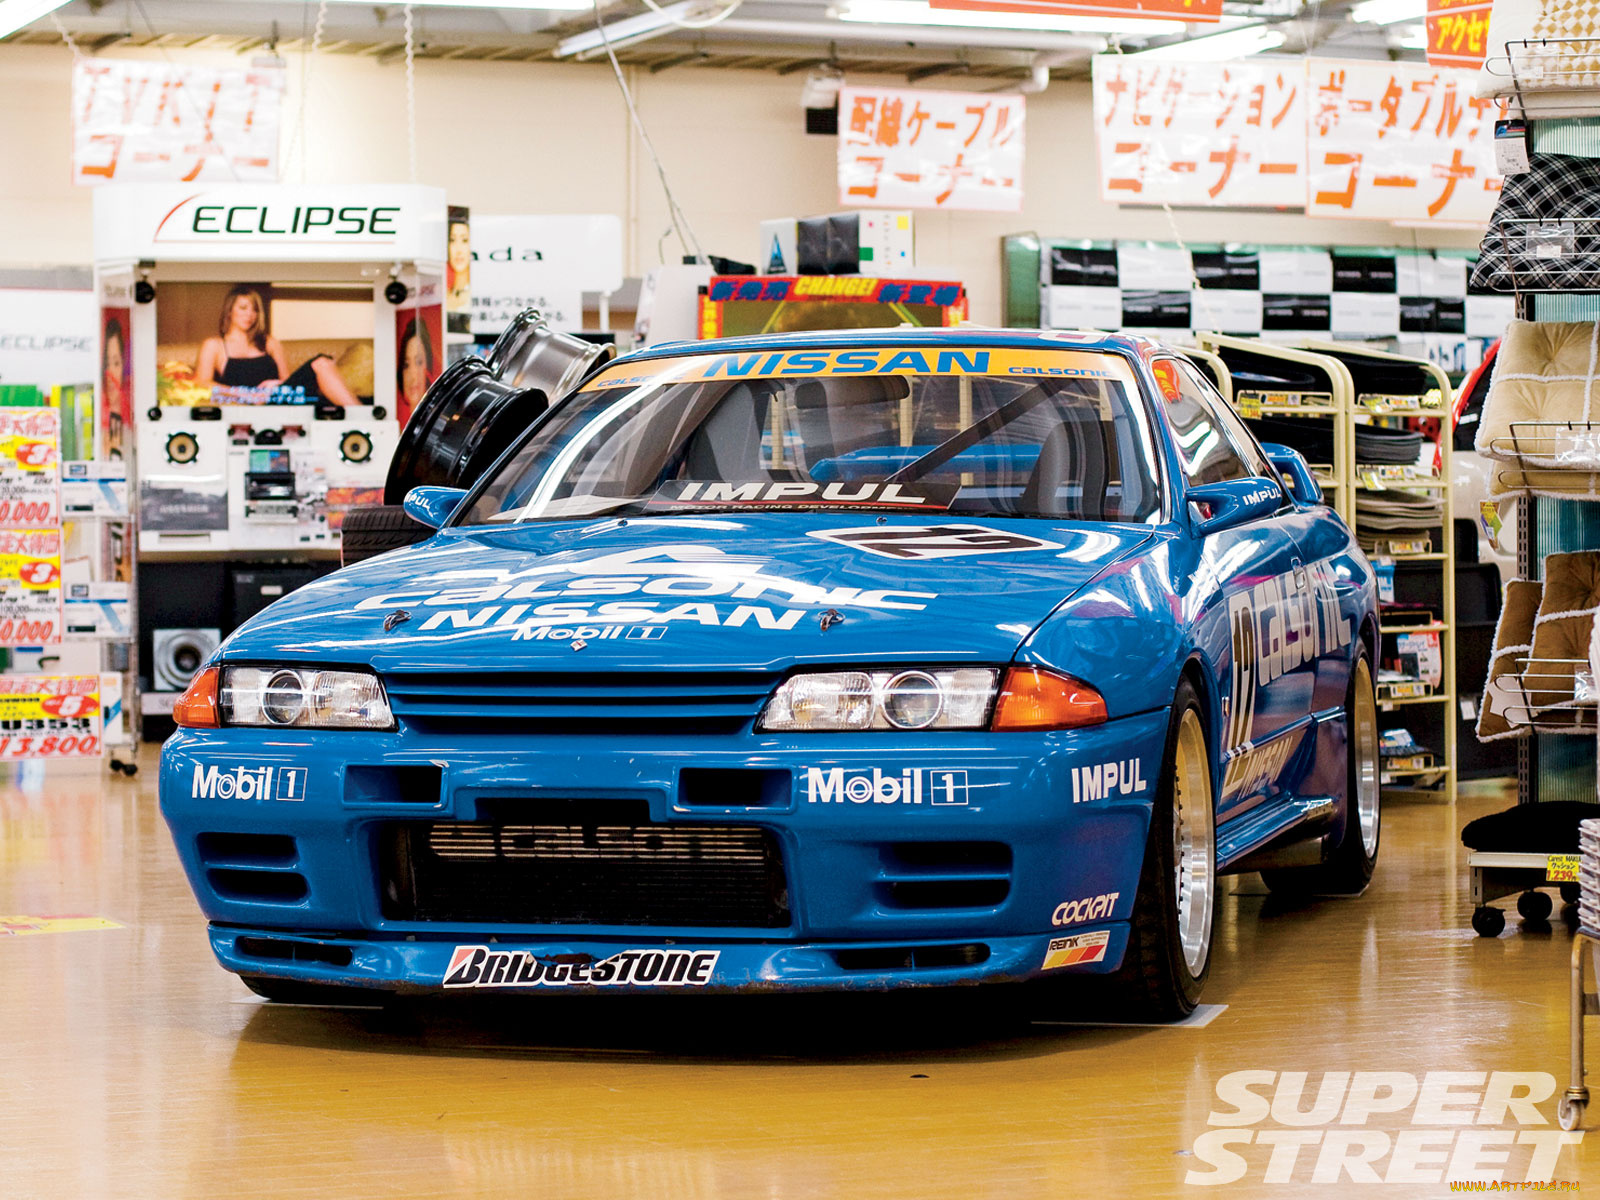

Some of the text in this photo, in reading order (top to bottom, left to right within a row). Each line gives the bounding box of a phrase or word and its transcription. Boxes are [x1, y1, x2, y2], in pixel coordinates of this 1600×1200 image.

[1436, 11, 1491, 52] アクセ
[81, 128, 269, 182] コーナー
[1108, 134, 1298, 199] コーナー
[848, 153, 1013, 205] コーナー
[192, 206, 401, 235] ECLIPSE
[794, 276, 878, 297] CHANGE!
[703, 351, 990, 377] NISSAN
[677, 482, 926, 503] IMPUL
[1242, 488, 1282, 505] IMPUL
[354, 576, 938, 611] calsonic
[418, 602, 807, 630] NISSAN
[511, 625, 625, 640] Mobil
[192, 765, 274, 800] Mobil
[808, 768, 922, 804] Mobil
[1071, 758, 1147, 803] IMPUL
[1051, 892, 1119, 926] COCKPIT
[444, 948, 718, 985] BRIDGESTONE
